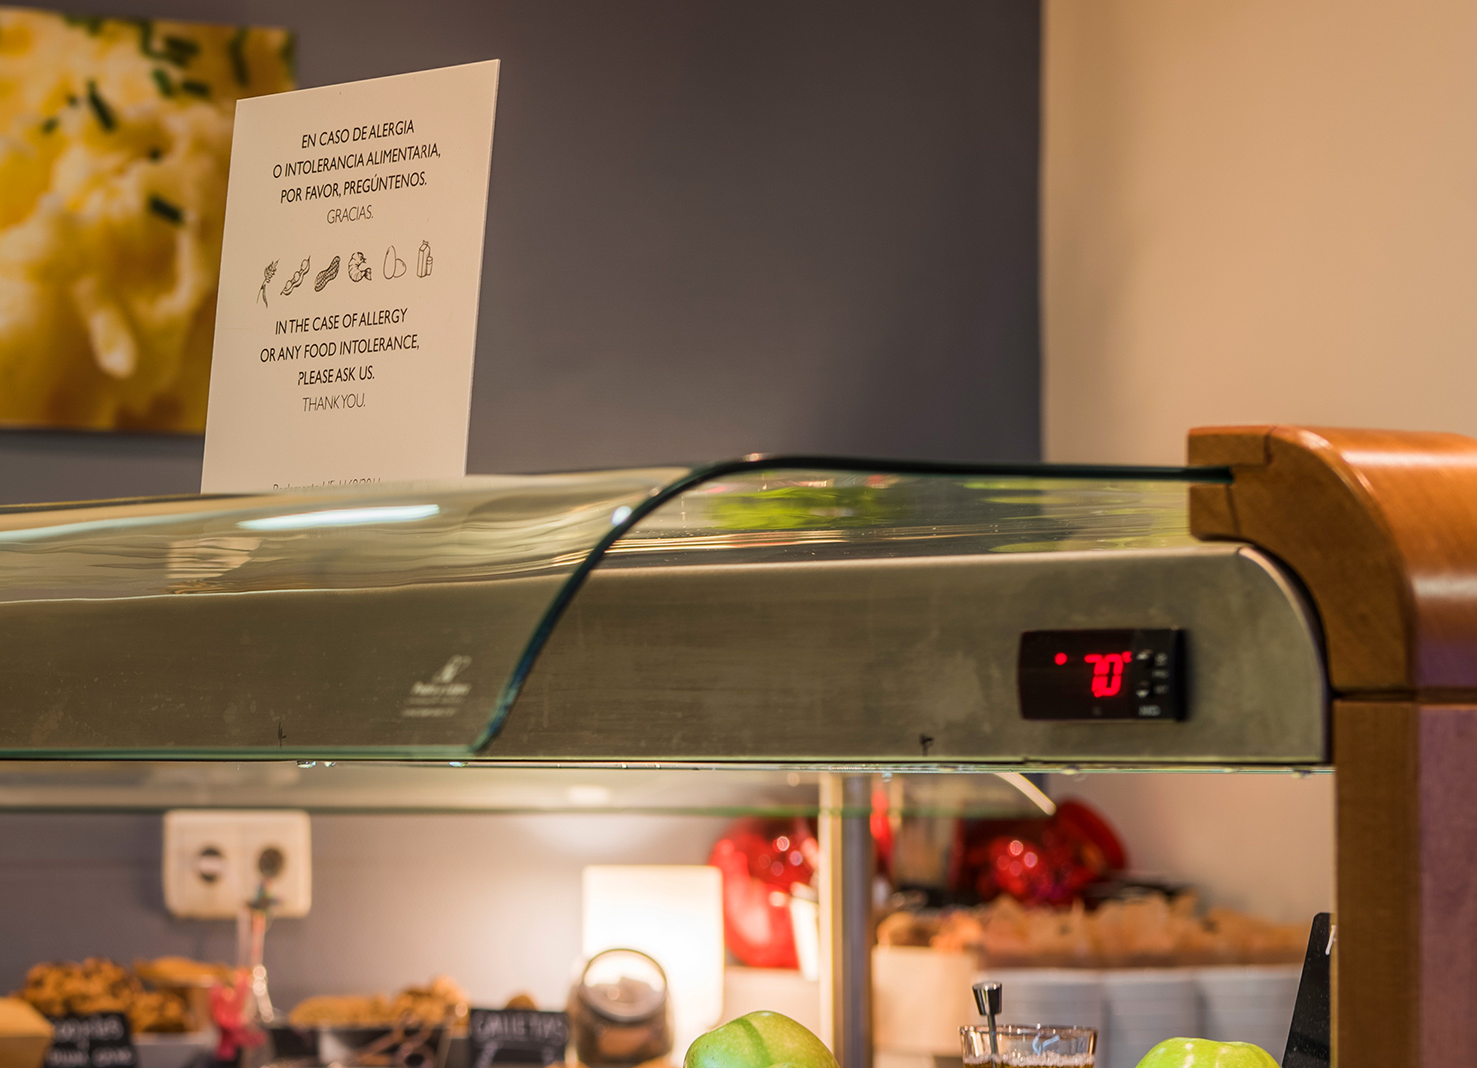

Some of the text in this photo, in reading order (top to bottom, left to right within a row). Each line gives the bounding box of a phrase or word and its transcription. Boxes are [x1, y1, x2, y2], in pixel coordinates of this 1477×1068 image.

[301, 119, 415, 148] EN CASO DE ALERGIA
[272, 143, 441, 179] O INTOLERANCIA ALIMENTARIA,
[280, 171, 428, 203] POR FAVOR, PREGÚNTENOS.
[326, 204, 374, 224] GRACIAS.
[275, 308, 408, 335] IN THE CASE OF ALLERGY
[260, 334, 420, 362] OR ANY FOOD INTOLERANCE,
[297, 365, 375, 386] PLEASE ASK US.
[302, 392, 366, 412] THANK YOU.
